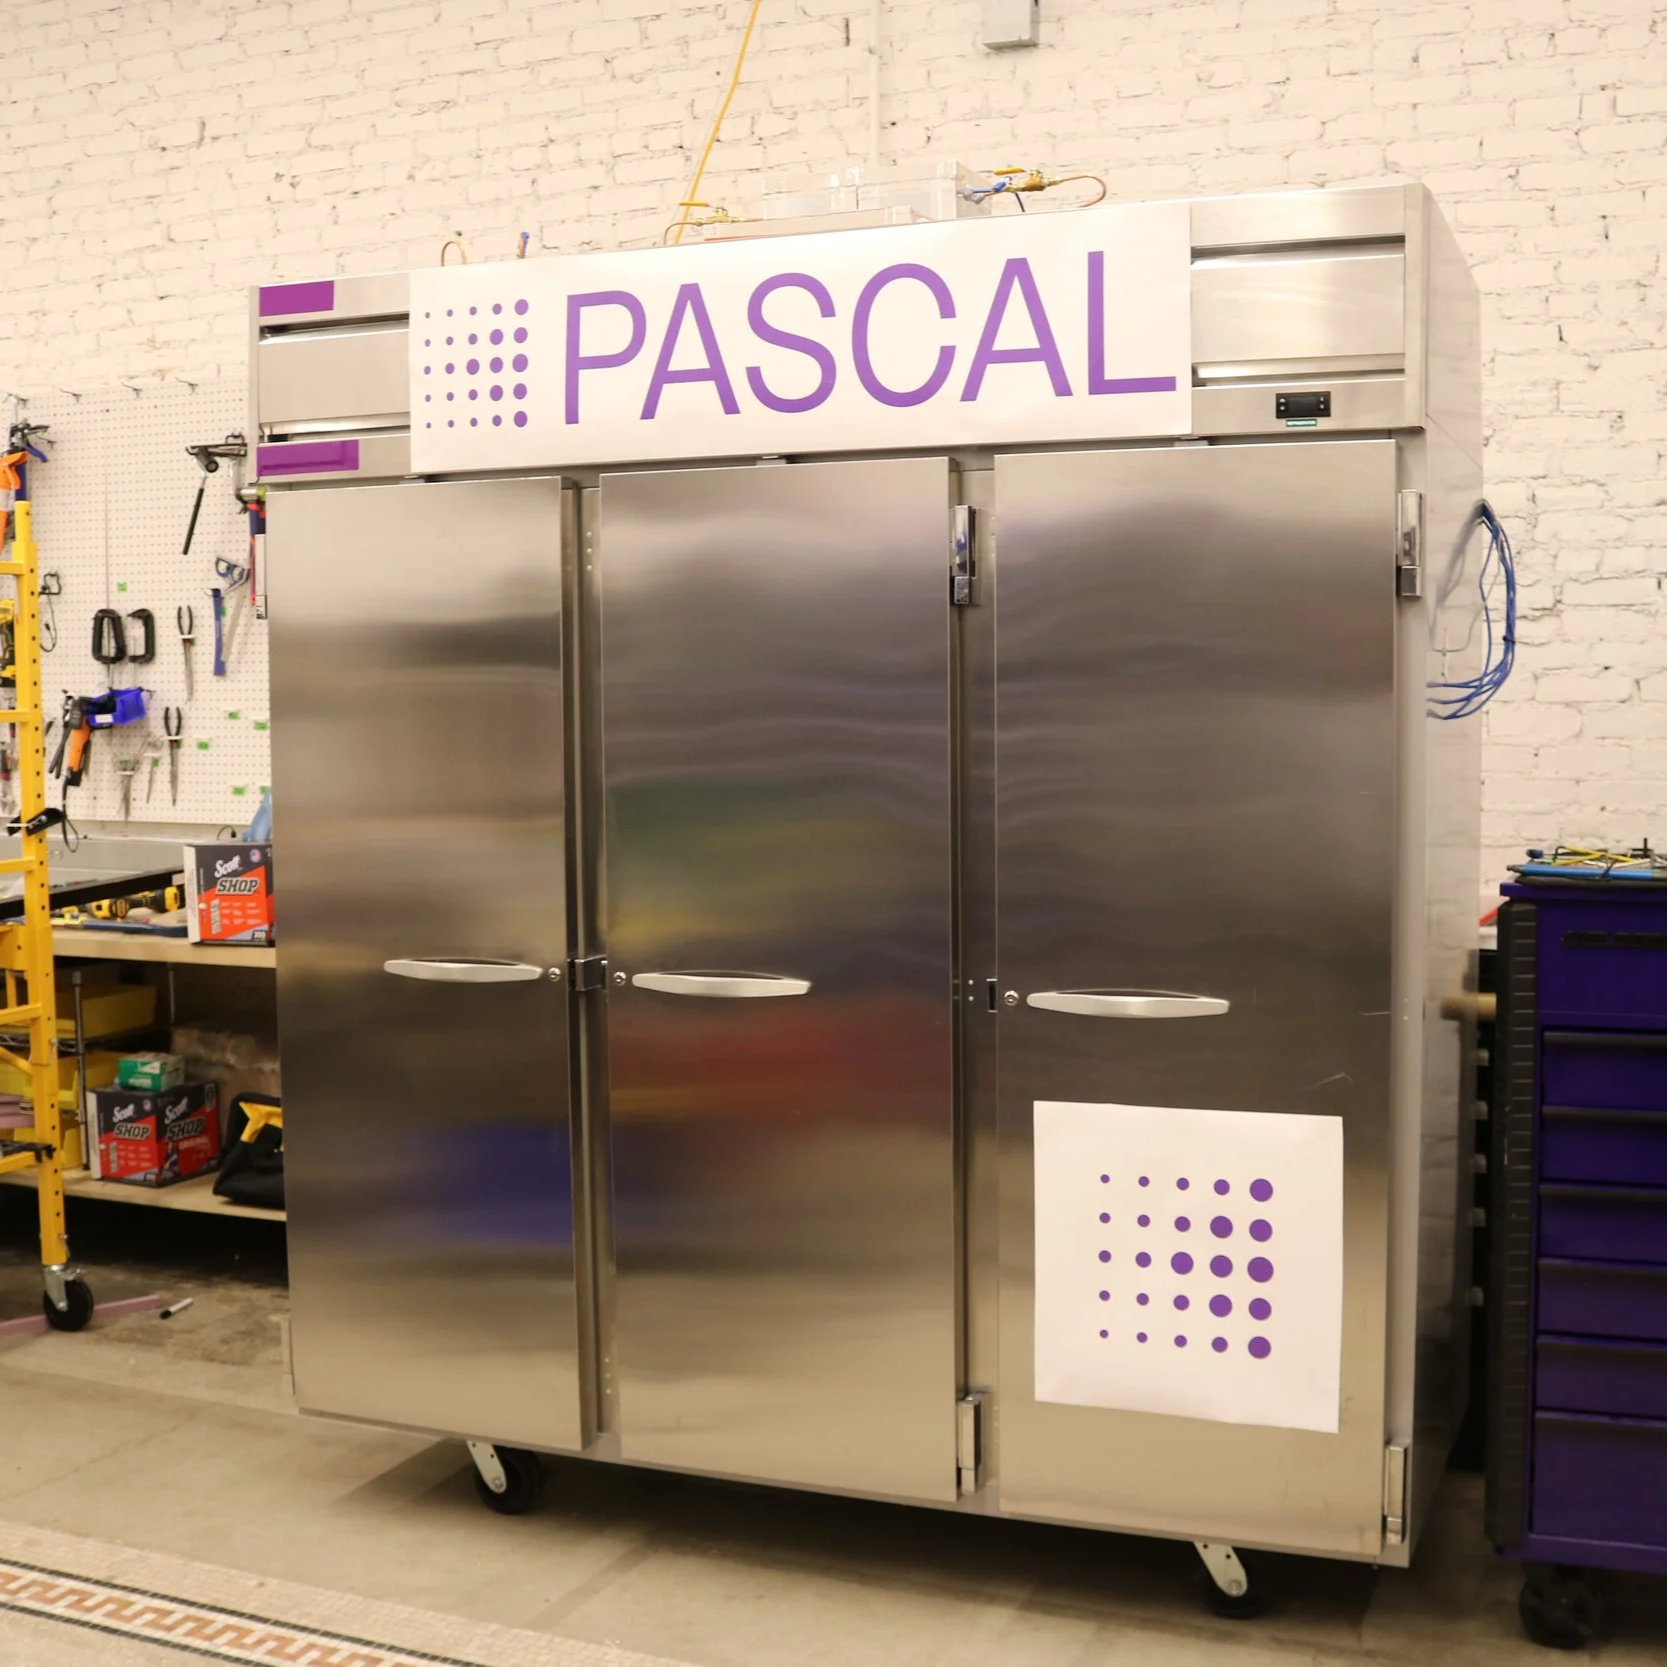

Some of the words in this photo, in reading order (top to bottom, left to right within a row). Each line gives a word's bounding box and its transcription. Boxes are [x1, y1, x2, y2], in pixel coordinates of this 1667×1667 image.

[564, 251, 1177, 425] PASCAL
[214, 855, 241, 878] Scott
[217, 878, 259, 894] SHOP
[112, 1103, 135, 1123] Scott
[164, 1098, 188, 1124] Scott
[115, 1123, 150, 1140] SHOP
[166, 1118, 205, 1142] SHOP
